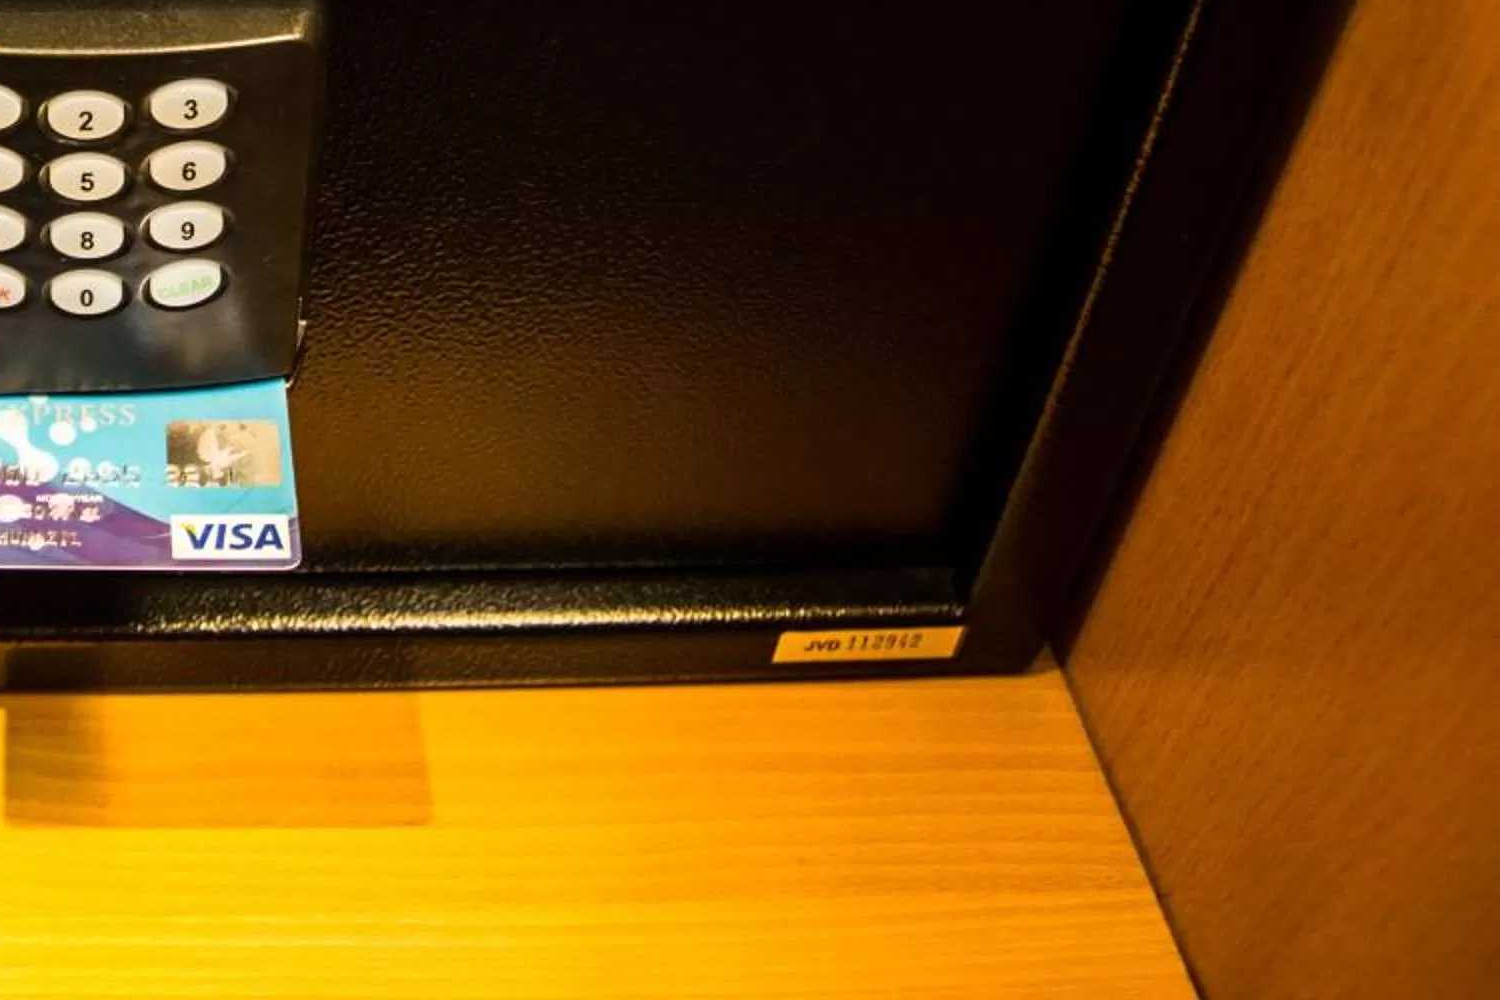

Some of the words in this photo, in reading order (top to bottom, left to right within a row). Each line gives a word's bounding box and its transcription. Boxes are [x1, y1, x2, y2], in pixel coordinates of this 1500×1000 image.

[184, 99, 199, 121] 3
[79, 111, 94, 131] 2
[182, 161, 197, 181] 6
[80, 172, 95, 192] 5
[80, 231, 94, 250] 8
[180, 221, 195, 241] 9
[79, 289, 94, 306] 0
[181, 523, 284, 550] VISA
